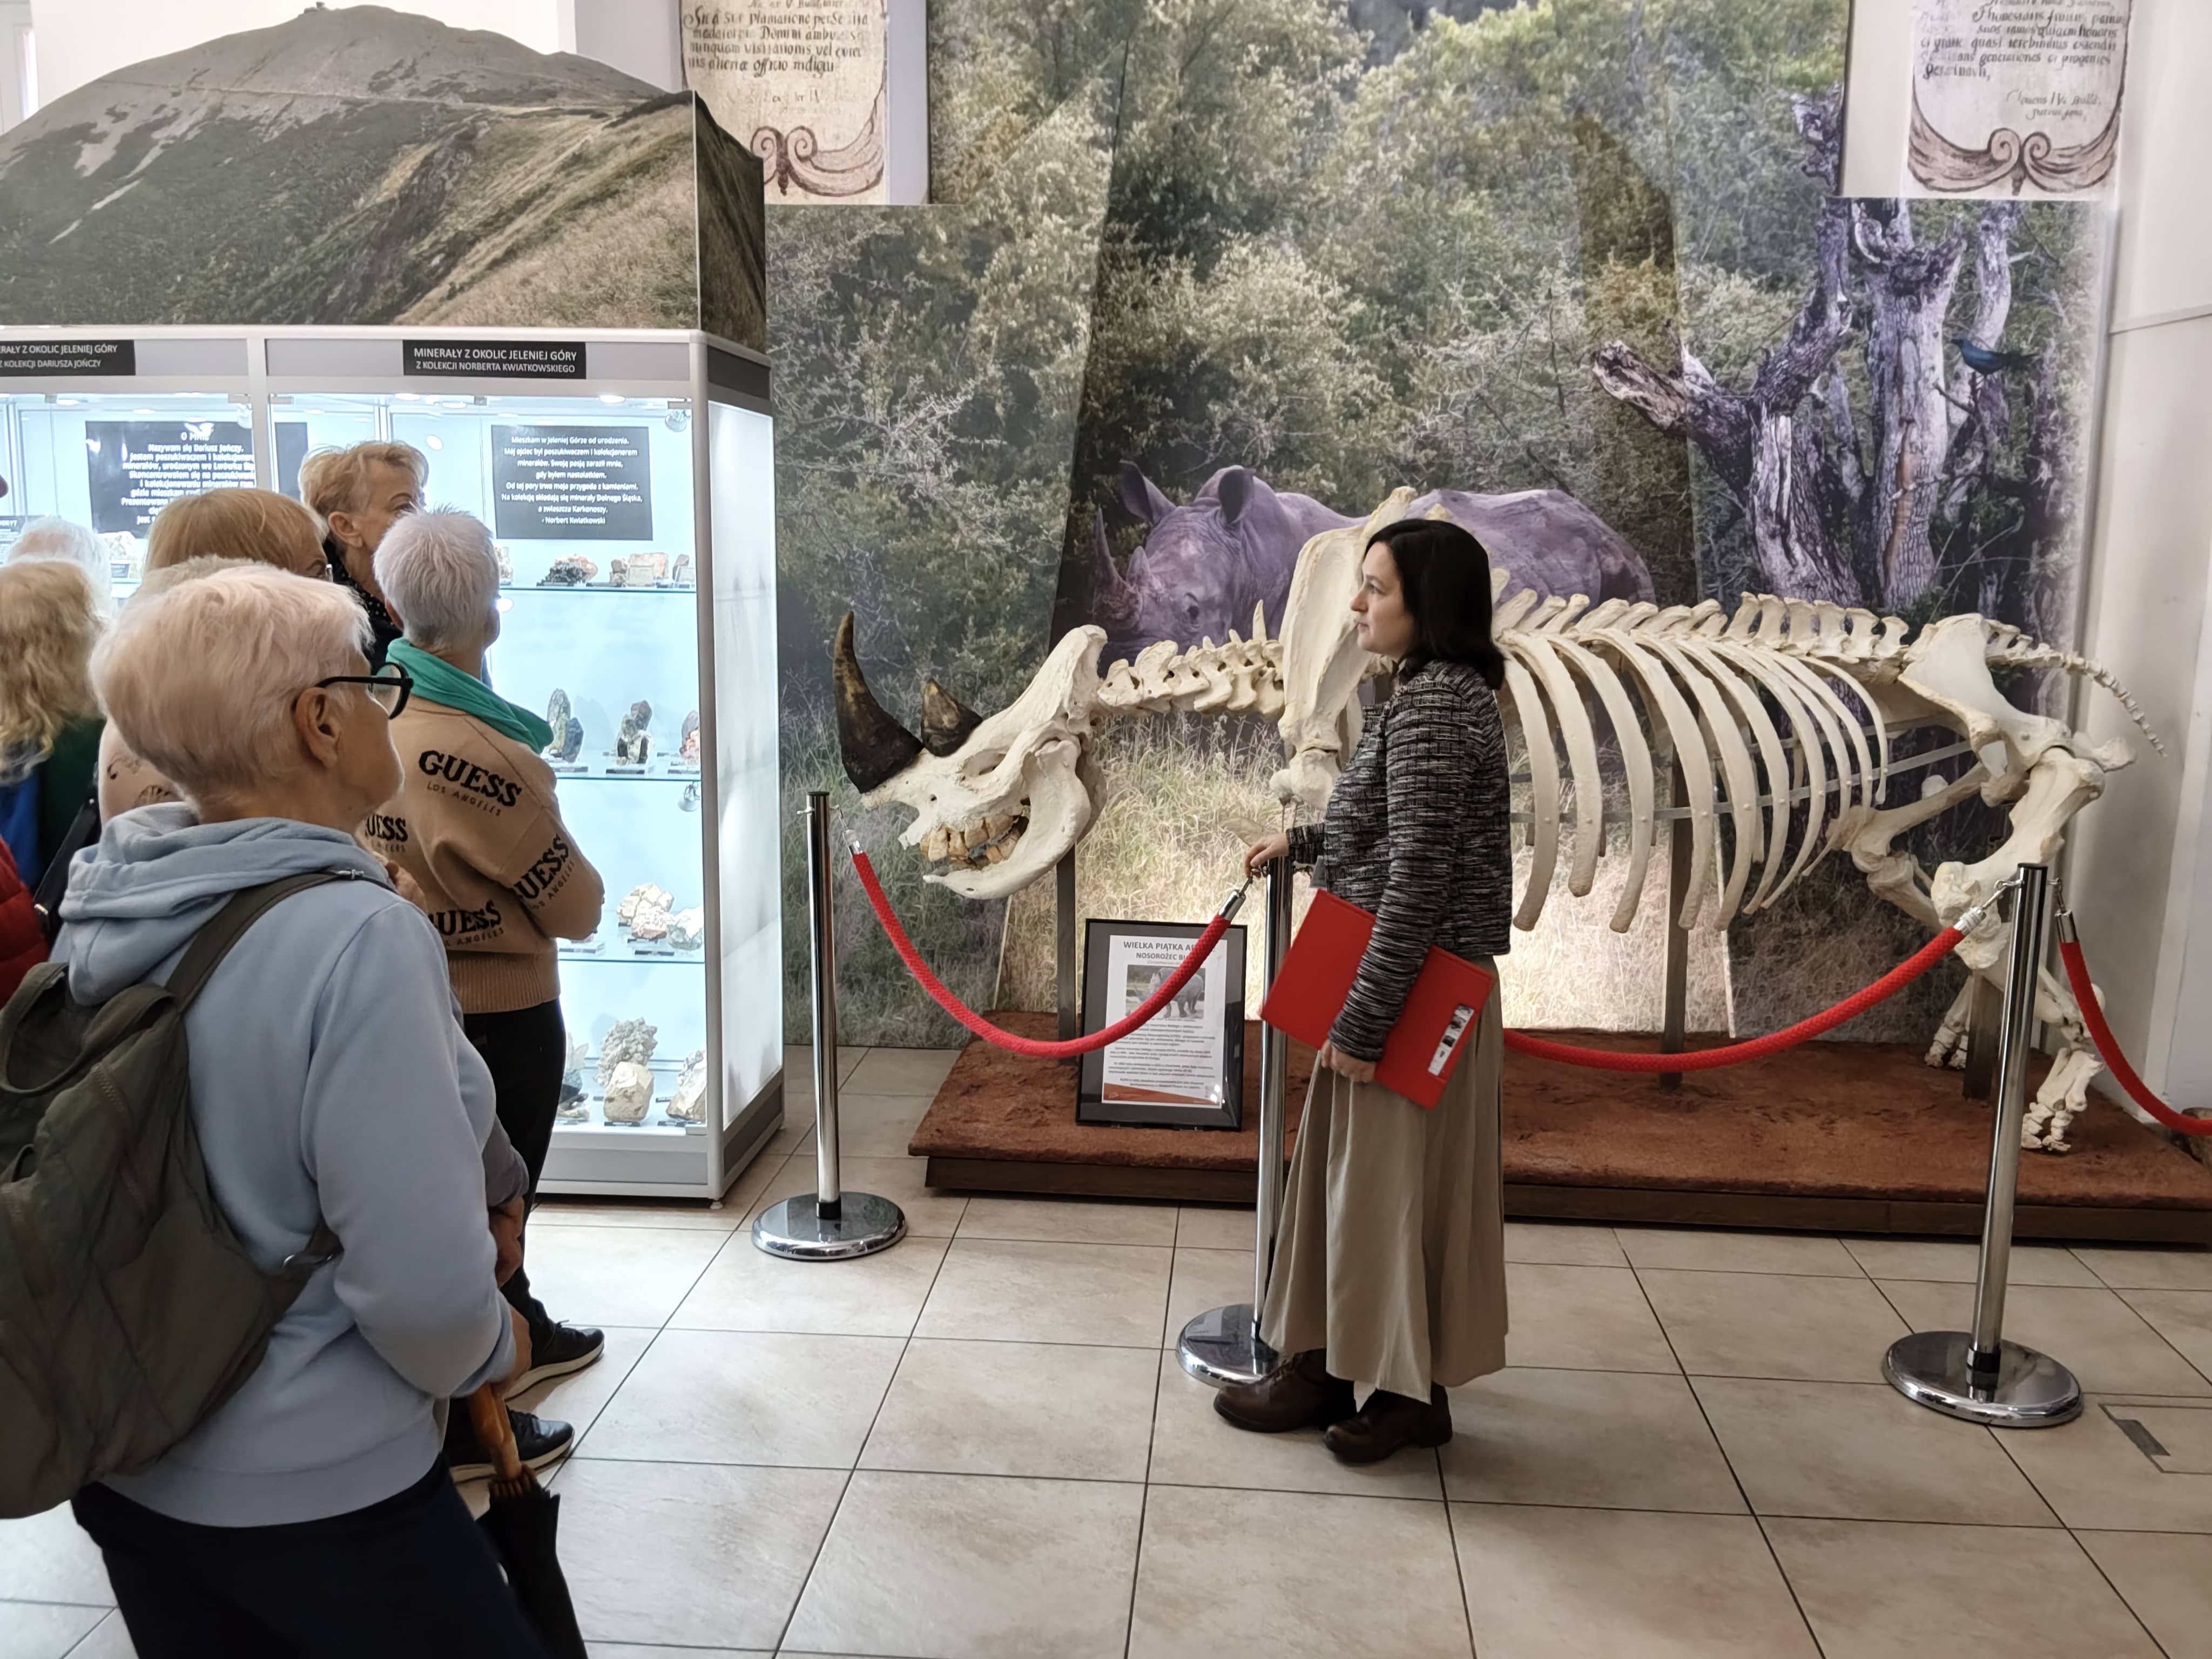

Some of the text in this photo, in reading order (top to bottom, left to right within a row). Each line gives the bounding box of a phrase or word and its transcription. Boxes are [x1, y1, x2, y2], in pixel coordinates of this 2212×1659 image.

[22, 345, 28, 354] Z
[29, 345, 59, 354] OKOLIC
[60, 345, 93, 355] JELENIEJ
[95, 343, 118, 353] GÓRY
[414, 348, 577, 361] MINERAŁY Z OKOLIC JELENIEJ GÓRY
[4, 360, 36, 369] KOLEKCJI
[37, 360, 73, 368] DARIUSZA
[73, 358, 102, 368] JOŃCZY
[415, 361, 575, 373] Z KOLEKCJI NORBERTA KWIATKOWSKIEGO
[548, 436, 568, 444] Jeleniej
[183, 444, 192, 453] się
[194, 444, 218, 452] Dariusz
[504, 448, 515, 457] Mój
[544, 448, 590, 456] poszukiwaczem
[525, 483, 538, 491] pory
[570, 483, 597, 491] przygoda
[597, 495, 621, 503] Dolnego
[419, 750, 522, 807] GUESS
[427, 781, 502, 817] LOS ANGELES
[365, 814, 408, 842] UESS
[514, 832, 569, 900] UESS
[428, 899, 501, 936] UESS
[1123, 941, 1154, 949] WIELKA
[1156, 943, 1184, 952] PIĄTKA
[1136, 952, 1178, 960] NOSOROŻEC
